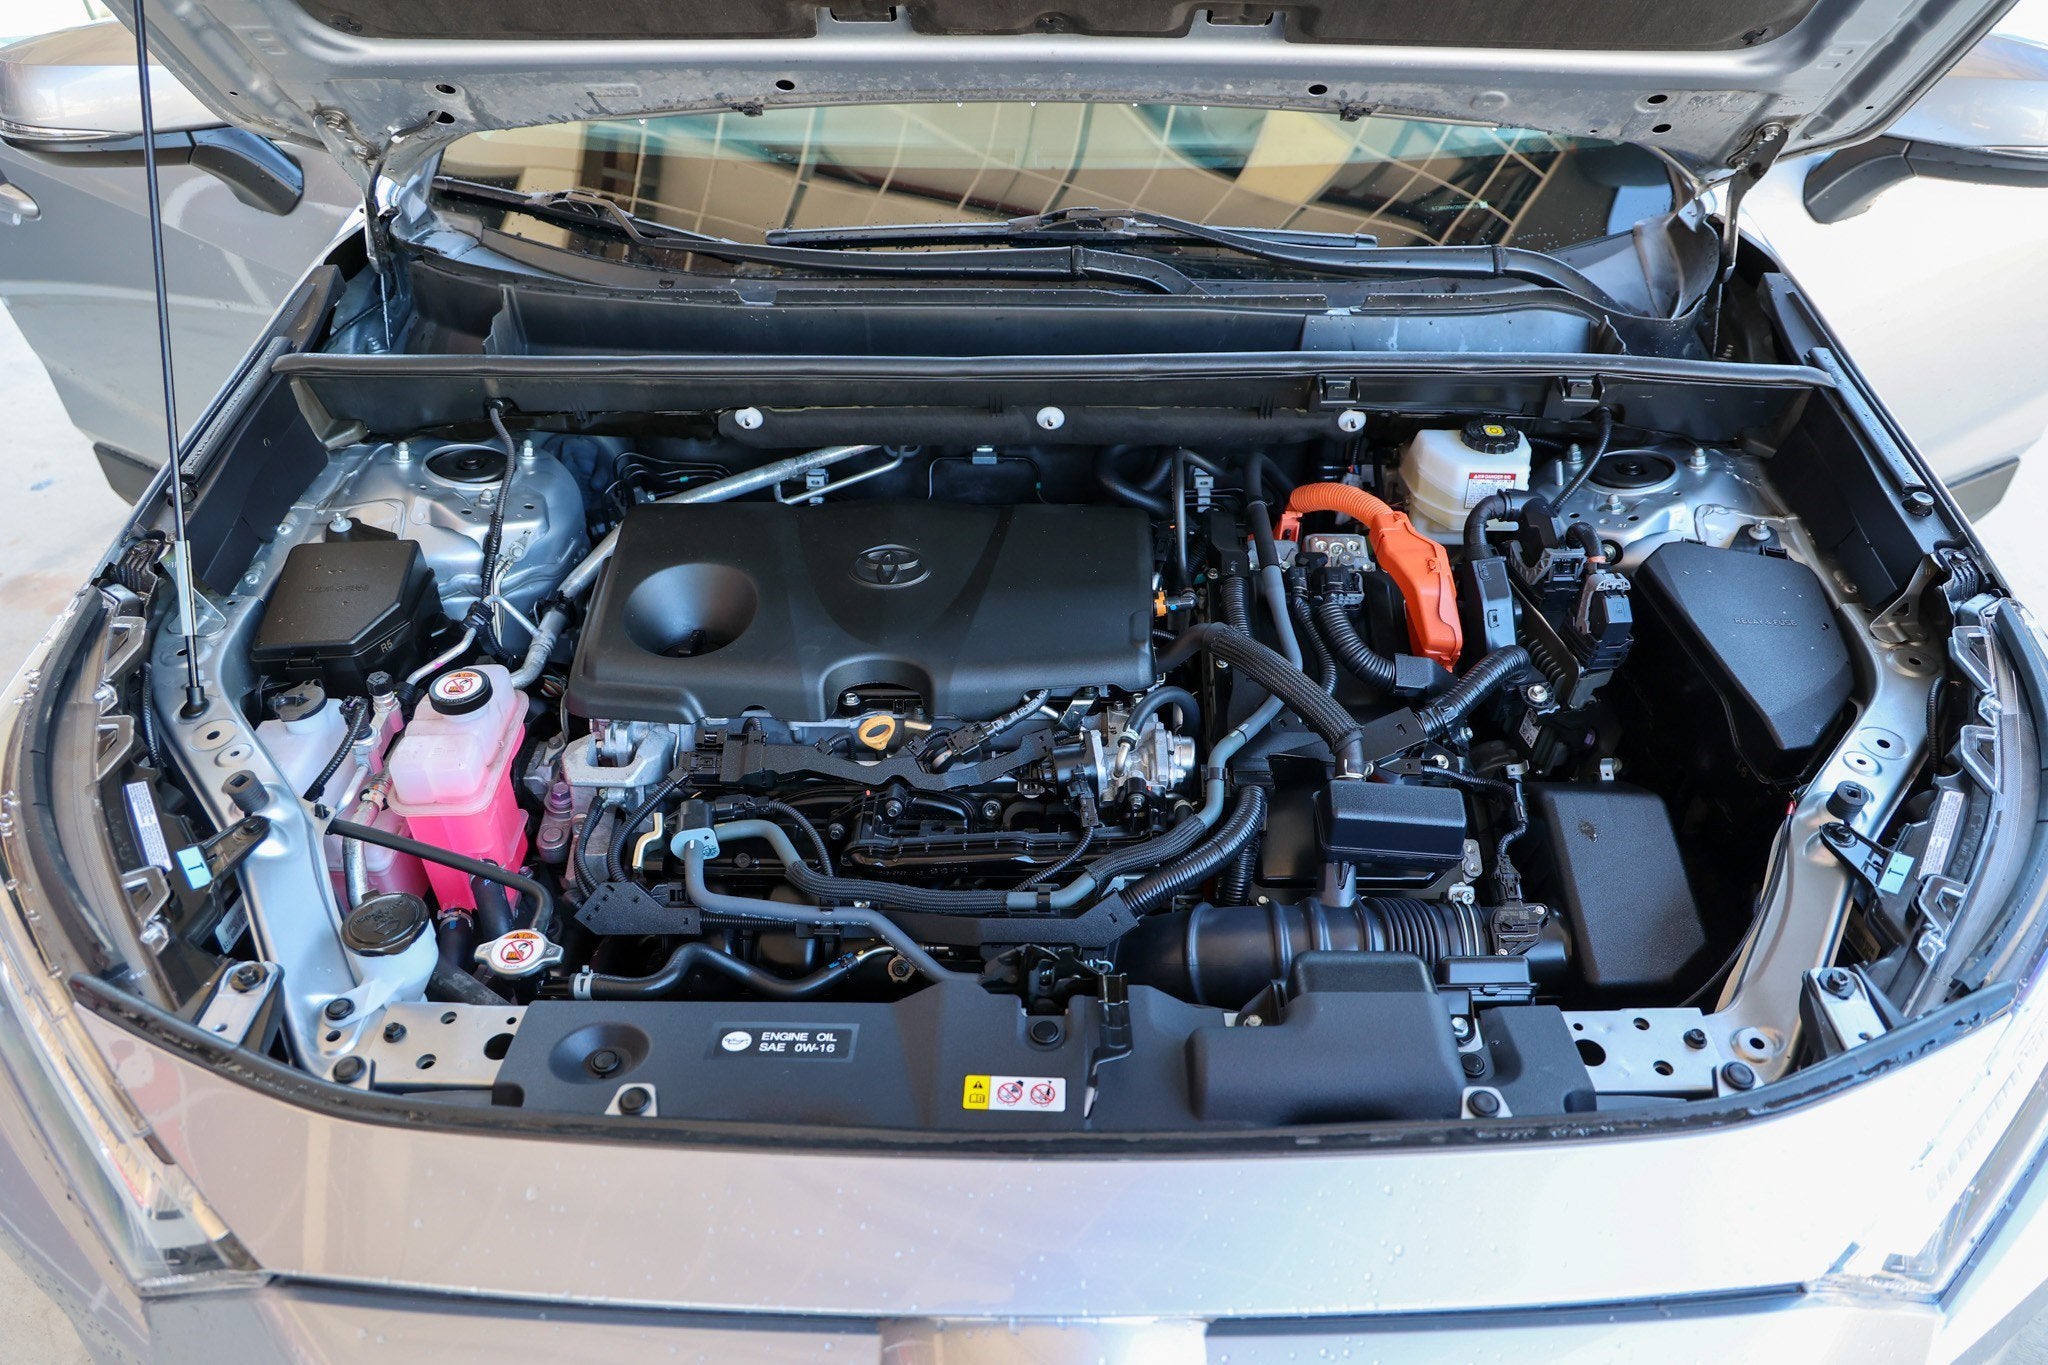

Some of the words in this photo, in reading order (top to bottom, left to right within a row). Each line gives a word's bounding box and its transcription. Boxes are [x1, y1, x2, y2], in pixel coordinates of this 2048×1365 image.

[1733, 617, 1763, 625] RELAY
[1773, 619, 1798, 627] FUSE
[761, 1031, 809, 1041] ENGINE
[816, 1032, 838, 1042] OIL
[758, 1042, 786, 1052] SAE
[794, 1043, 836, 1053] 0W-16
